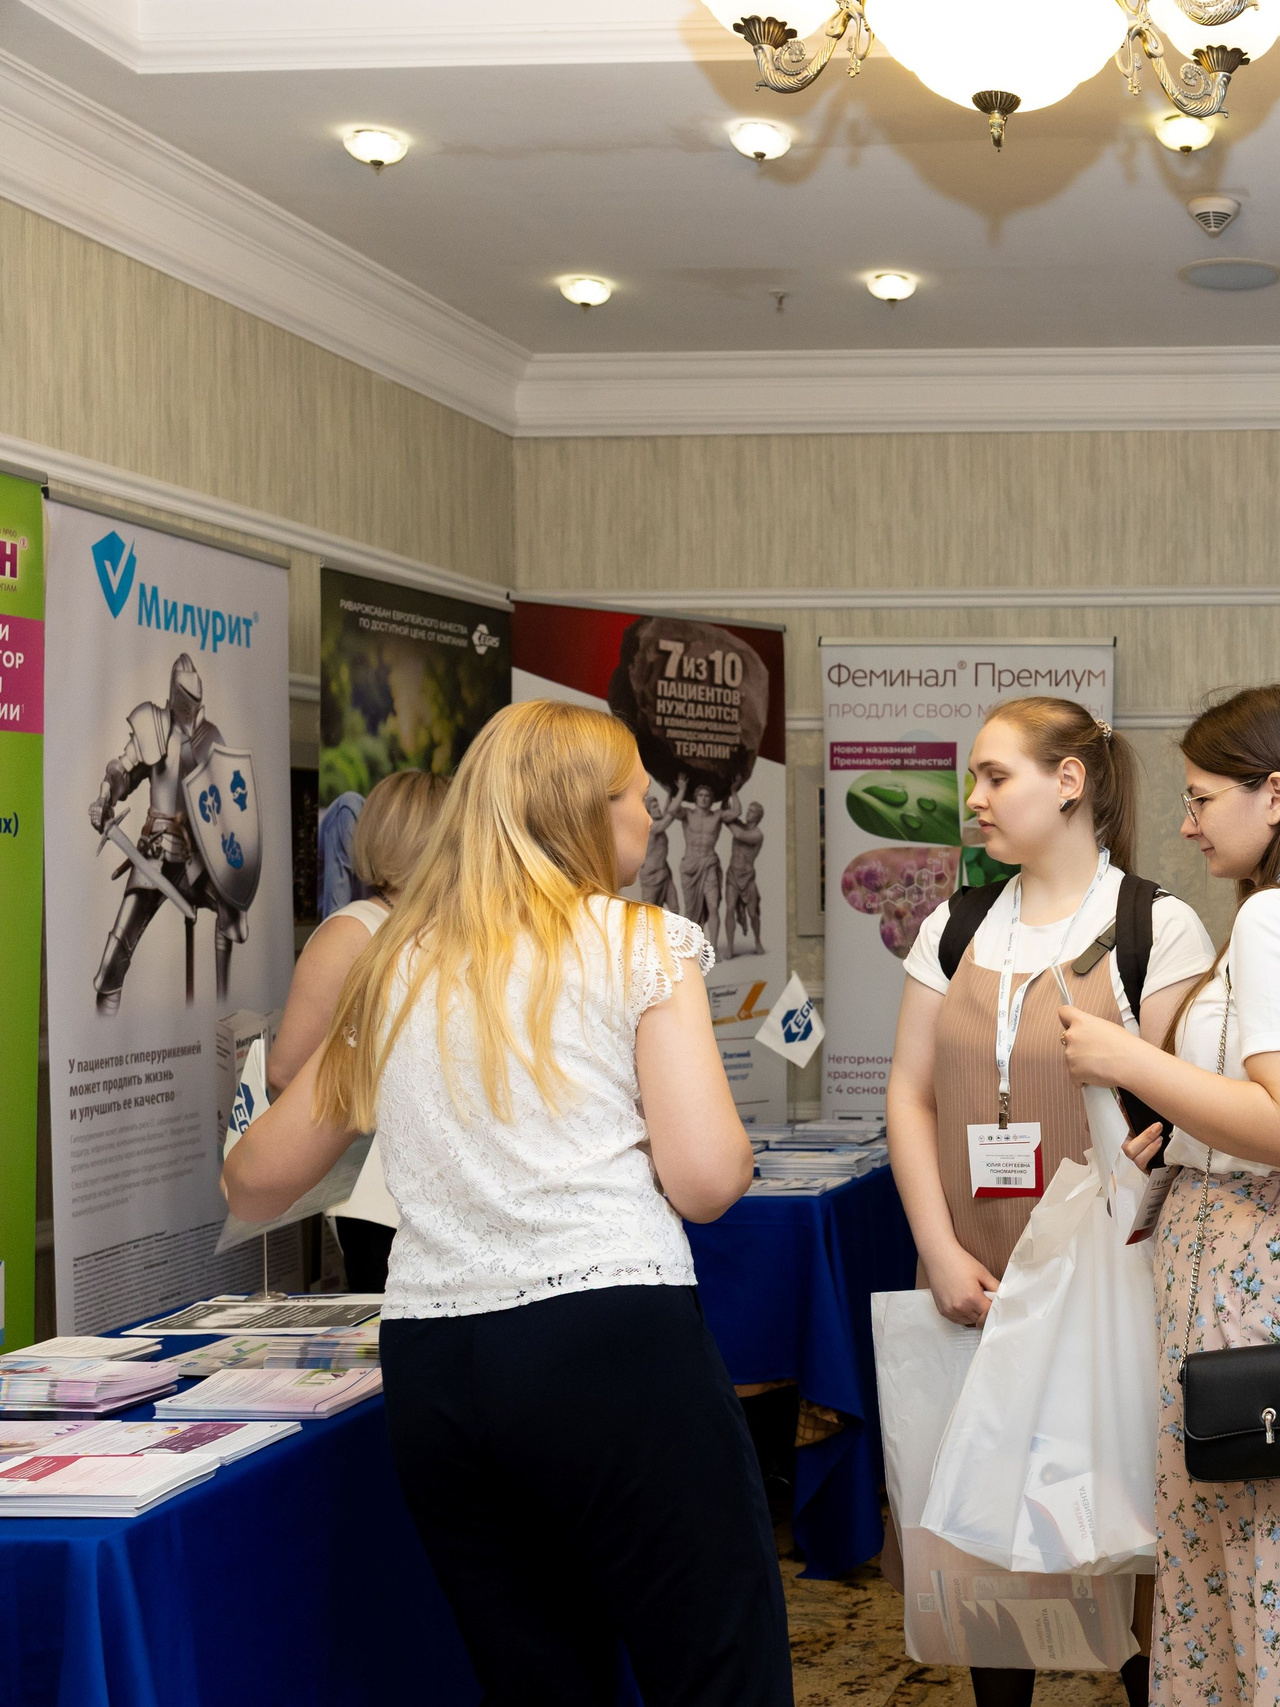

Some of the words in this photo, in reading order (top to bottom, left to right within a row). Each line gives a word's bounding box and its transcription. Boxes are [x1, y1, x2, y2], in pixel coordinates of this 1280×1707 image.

[0, 649, 25, 669] ОР
[659, 639, 685, 679] 7
[682, 655, 708, 681] ИЗ
[708, 650, 743, 688] 10
[974, 661, 1107, 693] Премиум
[656, 680, 742, 706] ПАЦИЕНТОВ
[655, 699, 740, 722] НУЖДАЮТСЯ
[827, 703, 908, 721] ПРОДЛИ
[912, 702, 973, 719] СВОЮ
[832, 756, 905, 768] Премиальное
[906, 755, 953, 768] качество!
[833, 744, 864, 755] Новое
[865, 744, 917, 755] название!
[68, 1059, 76, 1074] У
[77, 1057, 124, 1073] пациентов
[125, 1055, 130, 1065] с
[130, 1040, 202, 1065] гиперурикемией
[69, 1082, 101, 1097] может
[102, 1074, 143, 1094] продлить
[144, 1069, 174, 1085] жизнь
[827, 1069, 887, 1084] красного
[827, 1085, 833, 1094] с
[835, 1084, 844, 1094] 4
[70, 1108, 77, 1121] и
[79, 1100, 122, 1123] улучшить
[122, 1098, 132, 1109] ее
[134, 1090, 175, 1108] качество
[1079, 1485, 1095, 1529] ПАЦИЕНТА
